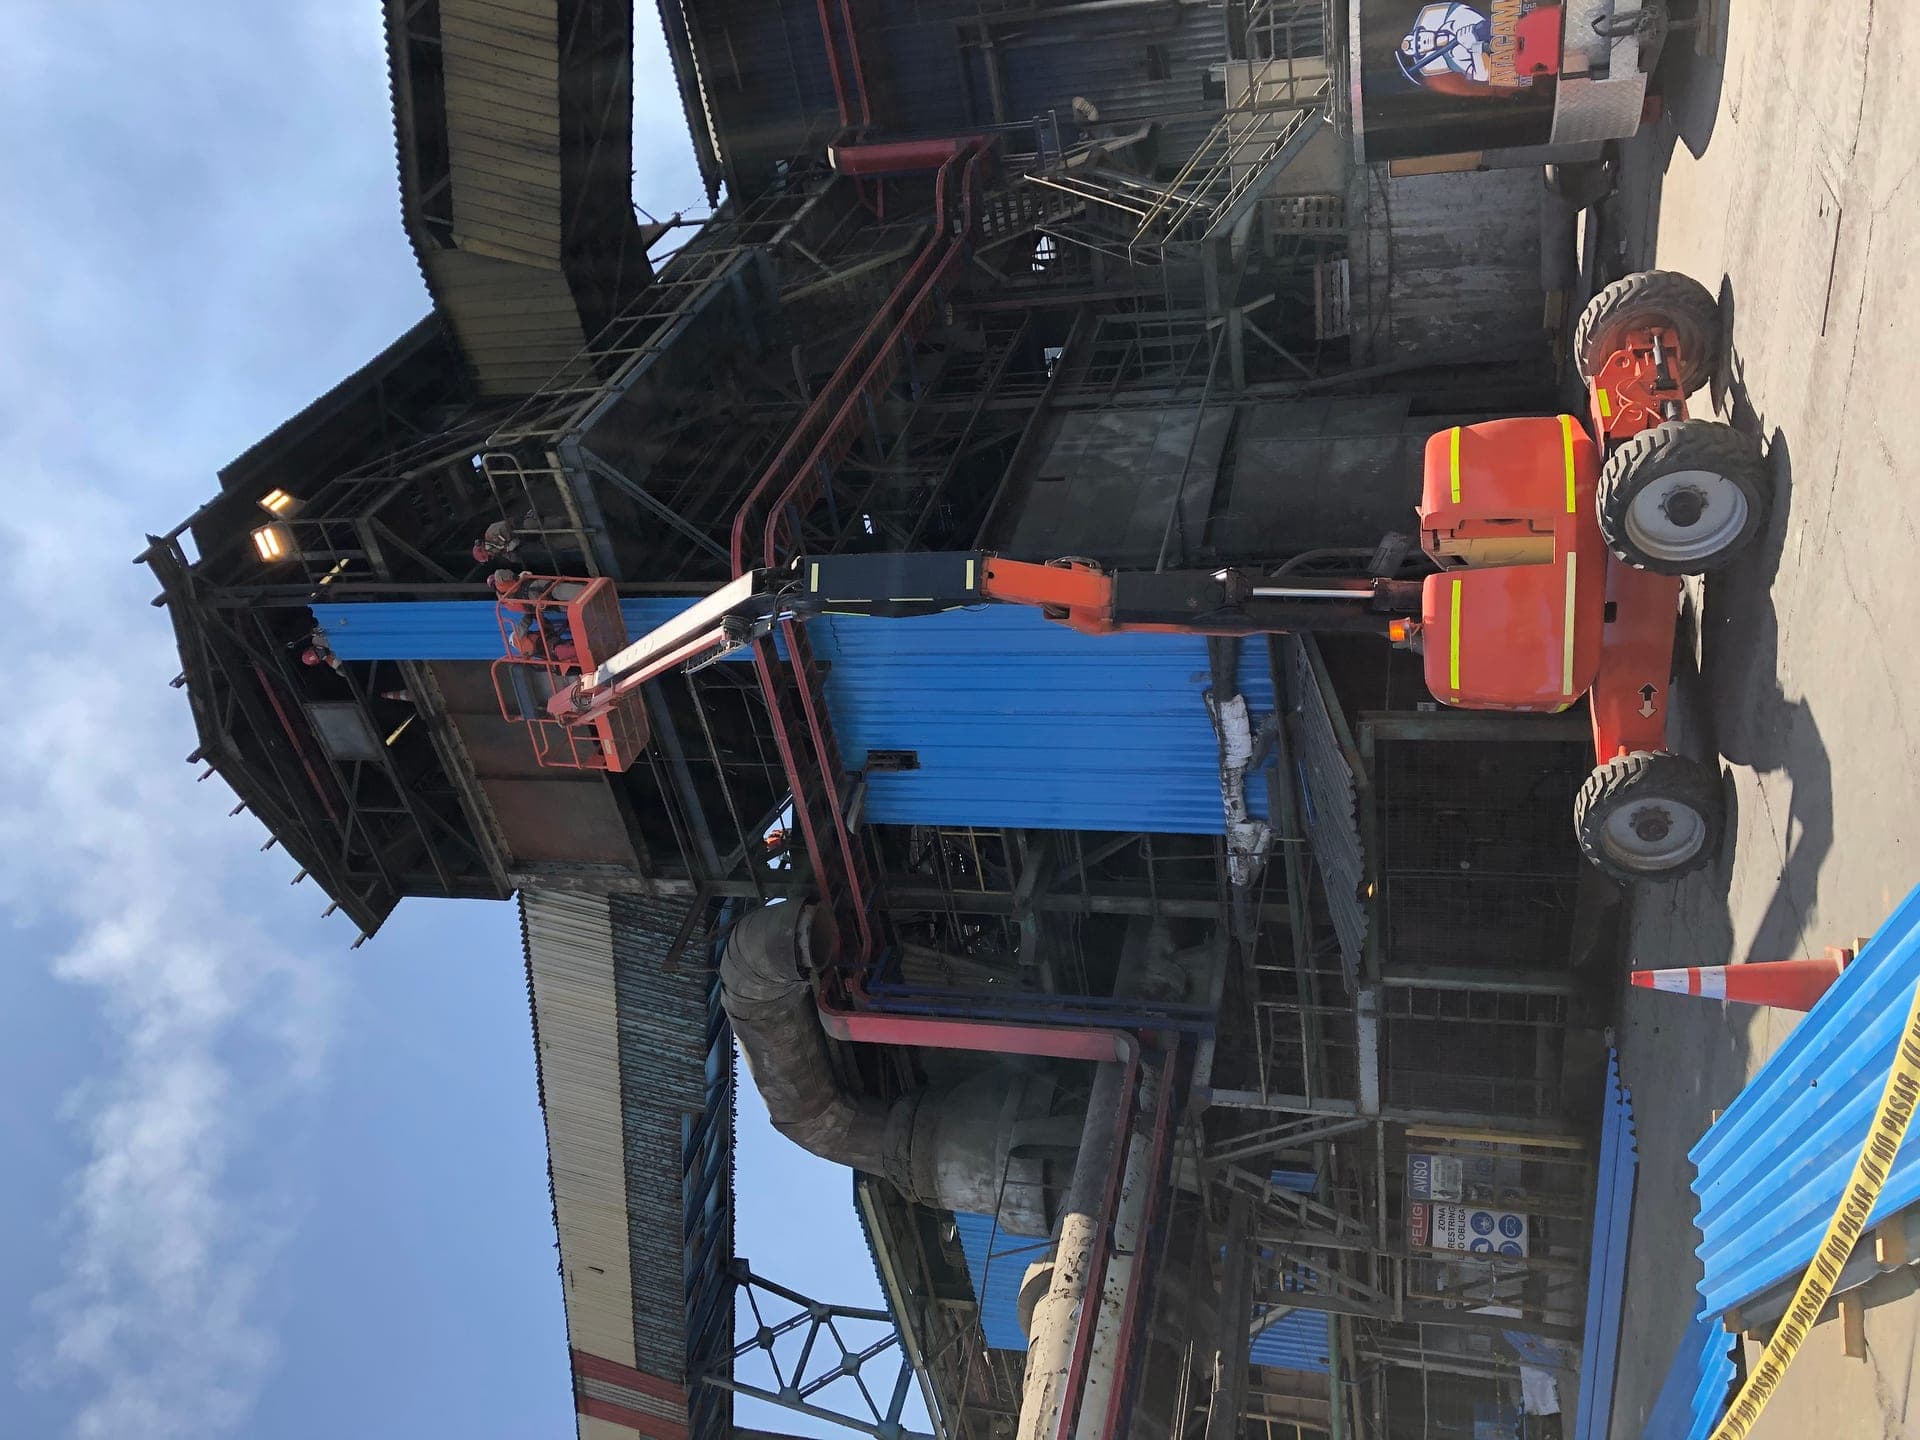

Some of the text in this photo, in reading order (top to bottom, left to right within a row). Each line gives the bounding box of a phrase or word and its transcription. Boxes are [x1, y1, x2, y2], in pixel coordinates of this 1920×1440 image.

[1881, 1072, 1920, 1136] PASAR
[1870, 1132, 1897, 1164] NO
[1413, 1160, 1428, 1193] AVISO
[1438, 1207, 1446, 1231] ZONA
[1837, 1183, 1874, 1241] PASAR
[1826, 1234, 1850, 1264] NO
[1791, 1279, 1827, 1329] PASAR
[1780, 1323, 1803, 1351] NO
[1747, 1361, 1781, 1406] PASAR
[1736, 1399, 1757, 1426] NO
